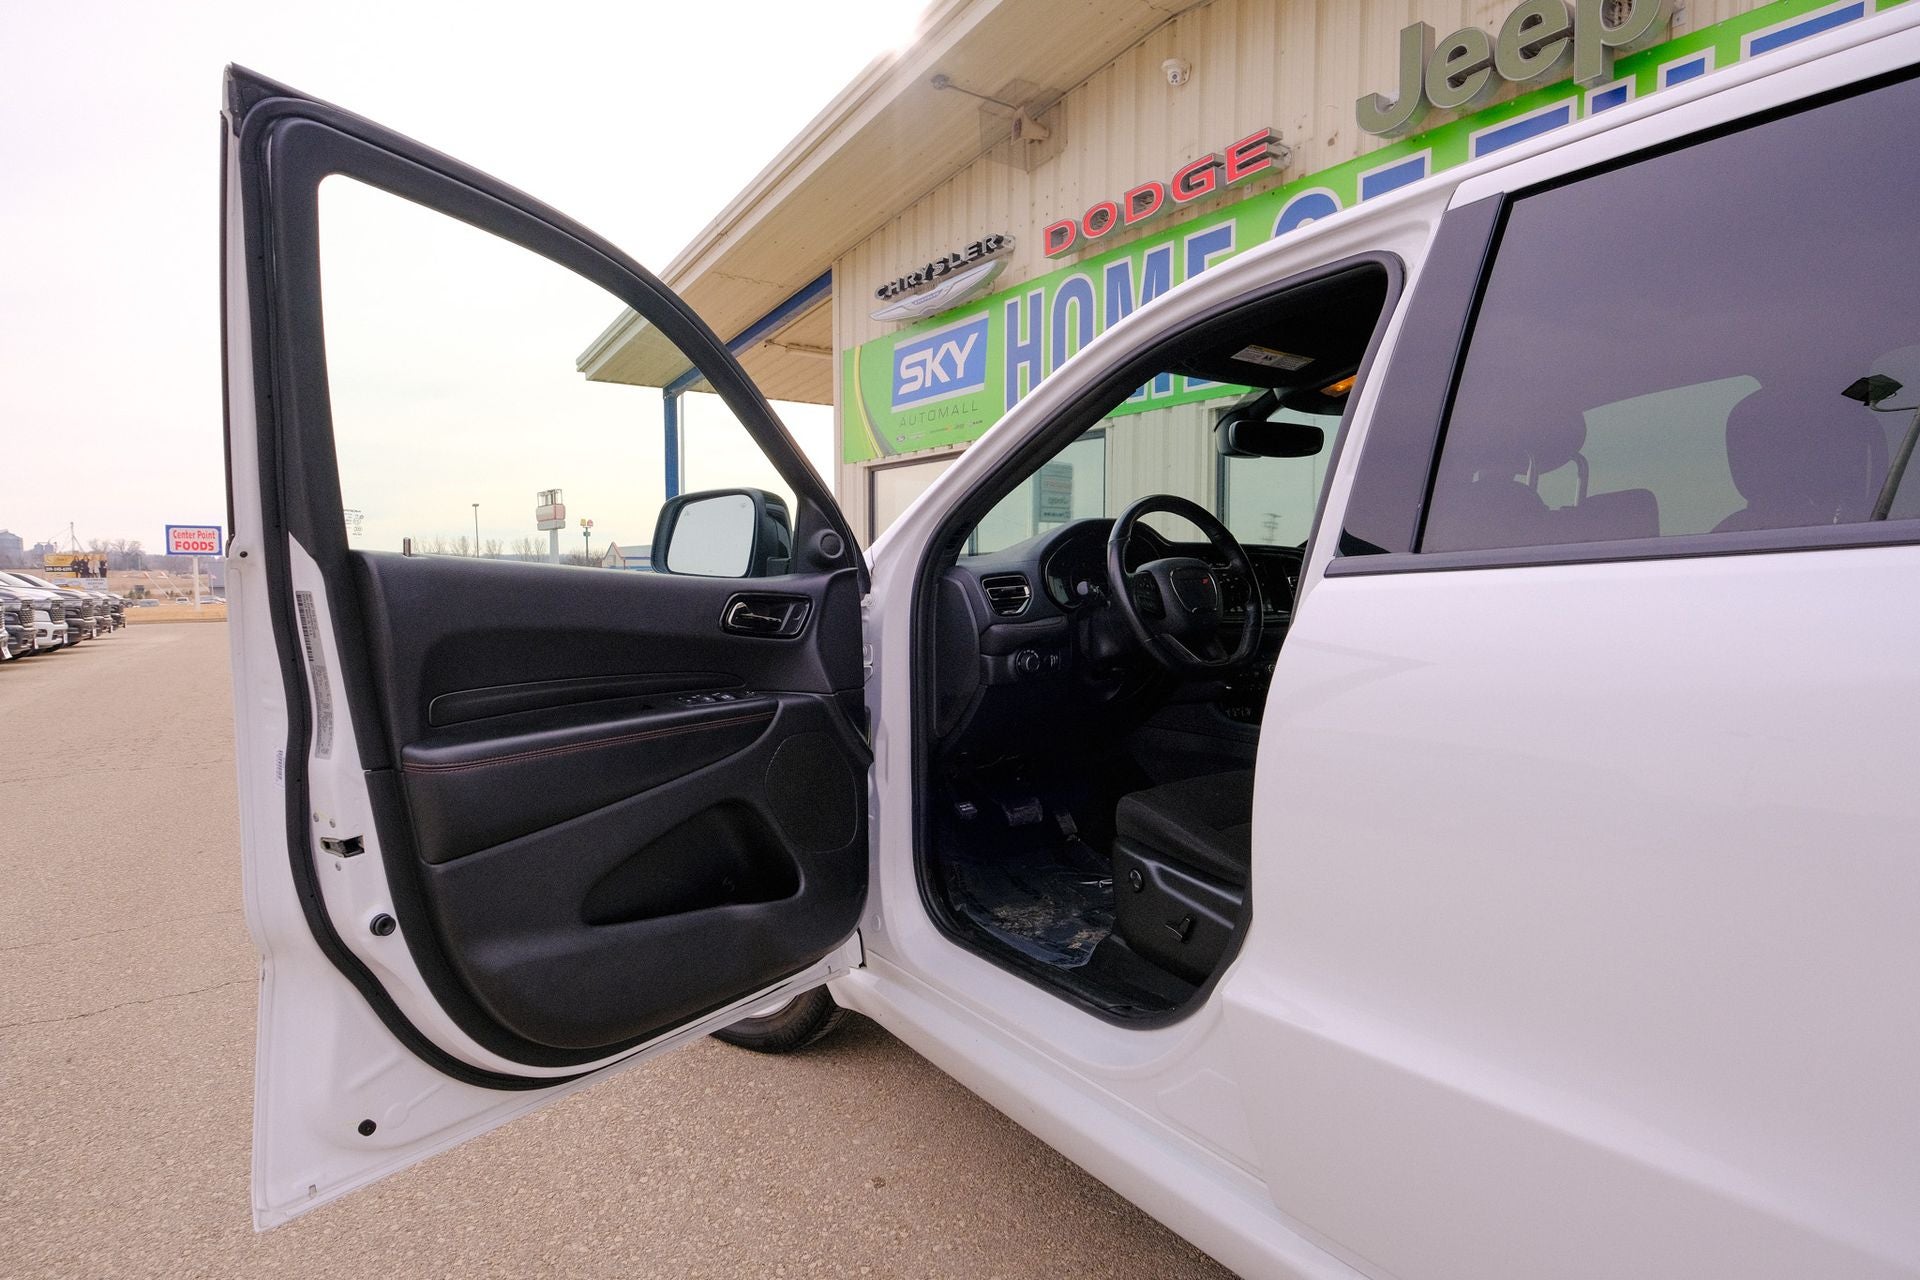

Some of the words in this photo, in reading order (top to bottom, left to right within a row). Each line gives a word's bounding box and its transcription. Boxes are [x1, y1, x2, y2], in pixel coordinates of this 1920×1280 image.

[1355, 0, 1662, 136] Jeep
[1043, 127, 1274, 258] DODGE
[874, 233, 1004, 300] CHRYSLER
[898, 332, 979, 395] SKY
[900, 399, 979, 427] AUTOMALL
[173, 530, 195, 539] Center
[197, 530, 216, 540] Point
[175, 541, 215, 551] FOODS
